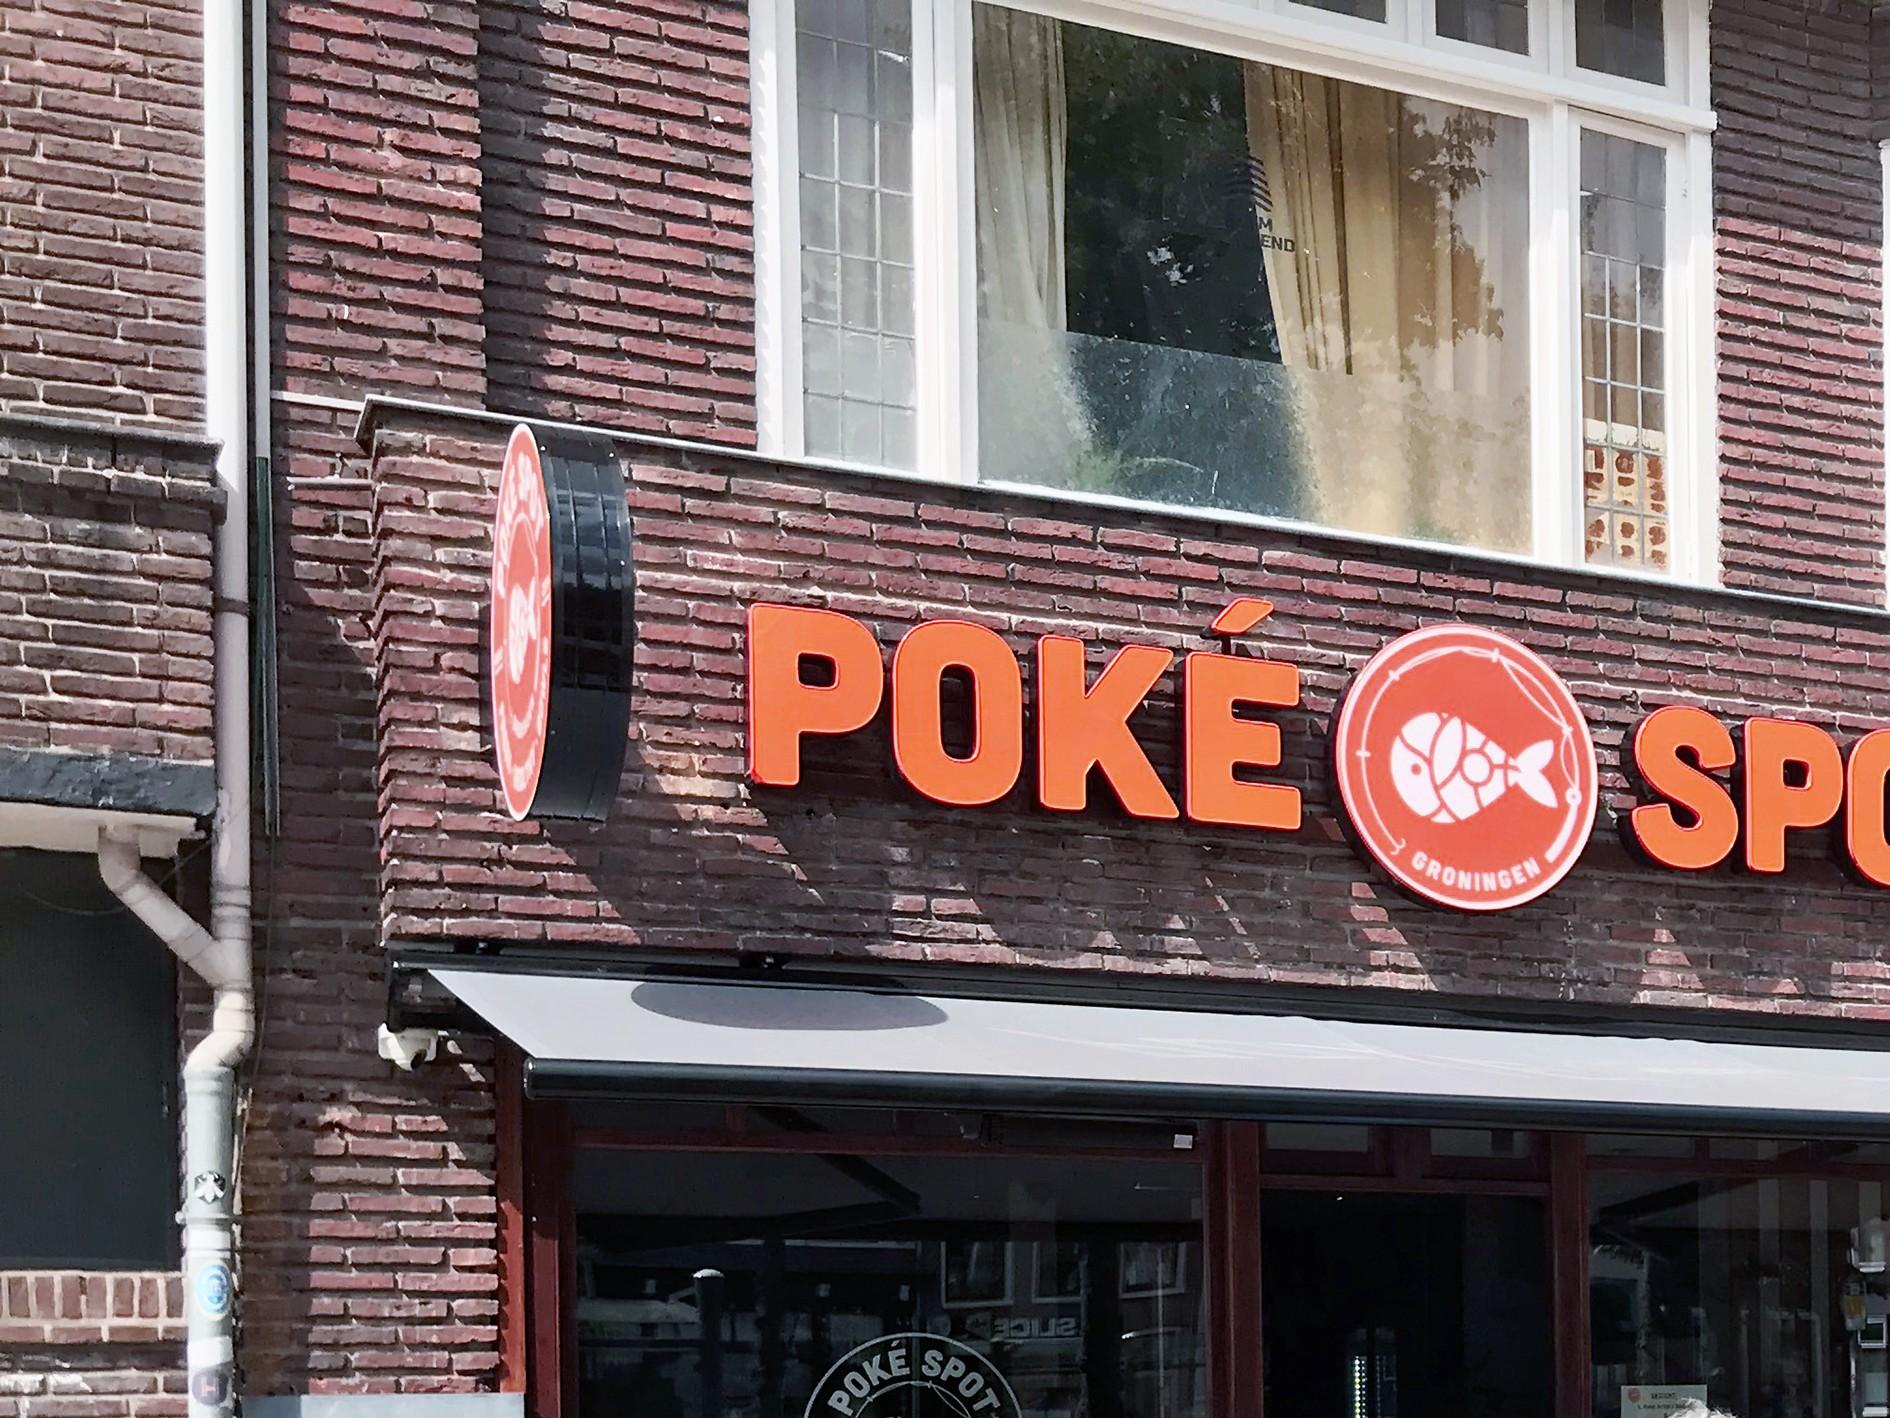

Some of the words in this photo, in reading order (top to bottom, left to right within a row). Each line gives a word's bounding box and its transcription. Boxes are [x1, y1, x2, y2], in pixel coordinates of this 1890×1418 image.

[745, 598, 1302, 831] POKÉ
[1410, 850, 1542, 892] GRONINGEN
[827, 1340, 911, 1417] POKÉ
[921, 1349, 1001, 1412] SPOT
